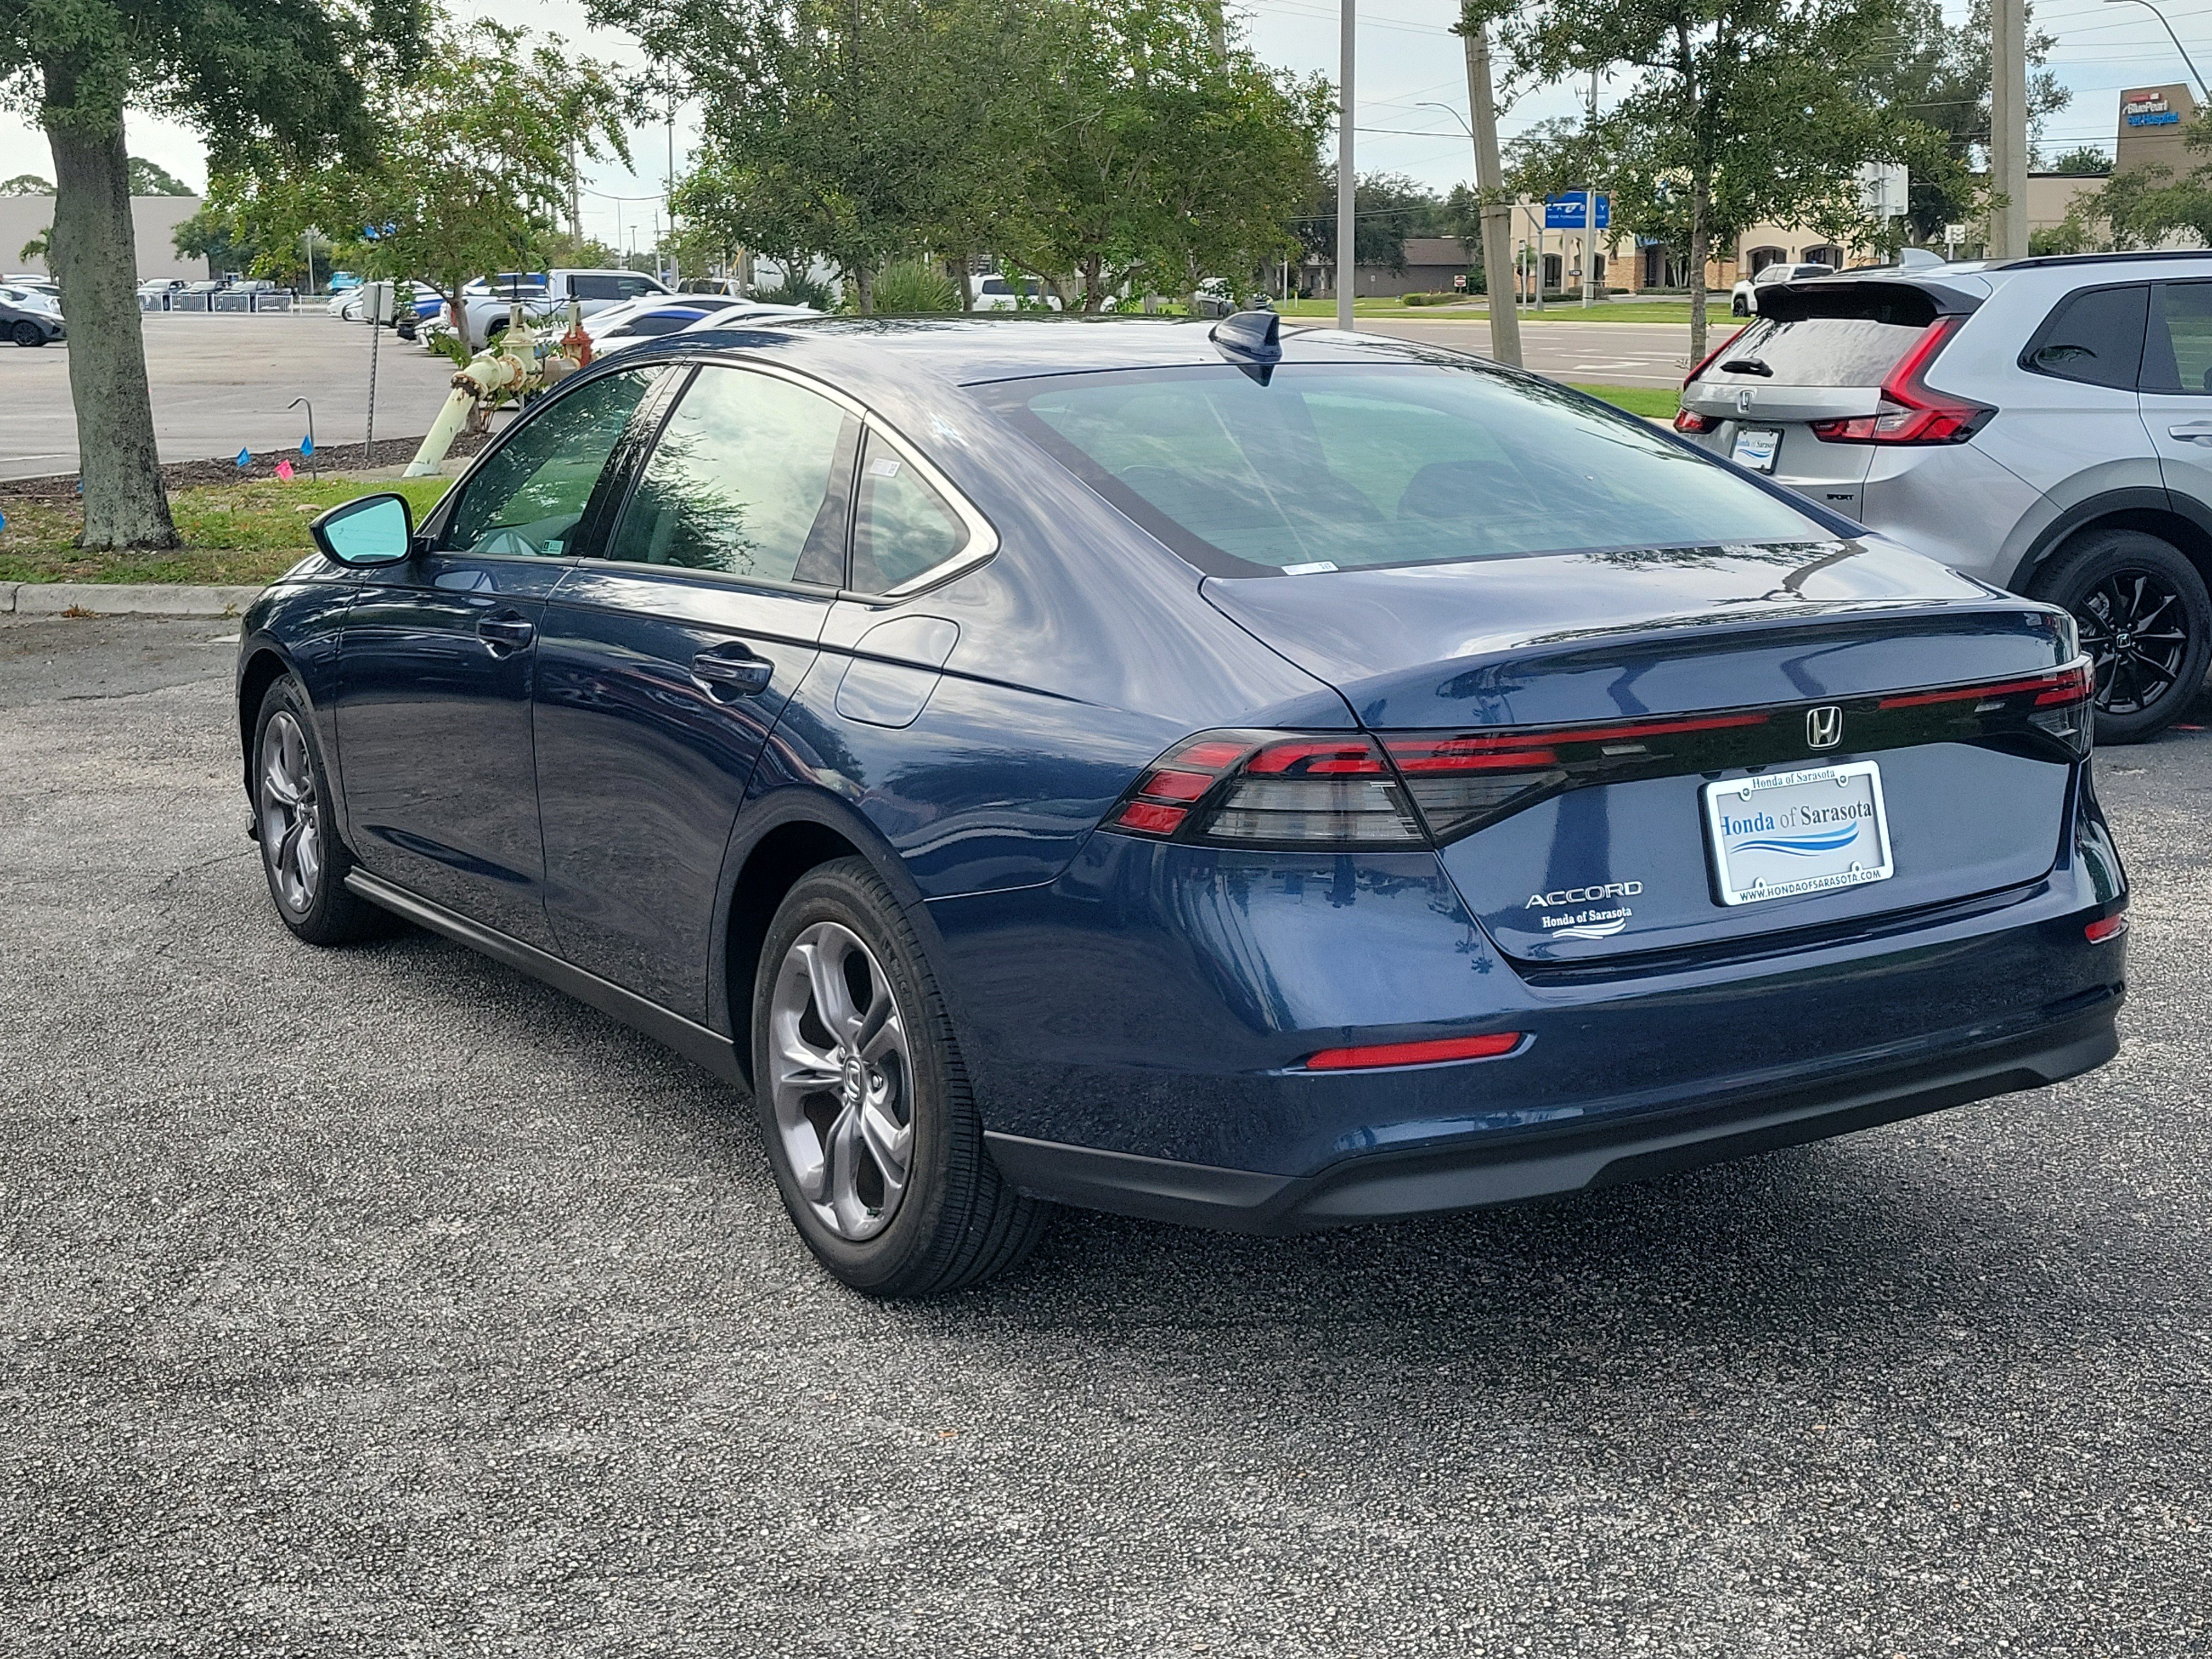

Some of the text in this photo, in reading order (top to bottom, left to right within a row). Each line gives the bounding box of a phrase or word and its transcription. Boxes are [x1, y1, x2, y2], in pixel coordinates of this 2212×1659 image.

[1752, 770, 1835, 788] Honda of Sarasota
[1780, 806, 1797, 828] of
[1800, 800, 1872, 826] Sarasota
[1525, 881, 1643, 909] ACCORD
[1740, 870, 1881, 901] WWW.HONDAOFSARASOTA.COM
[1542, 907, 1632, 928] Honda of Sarasota
